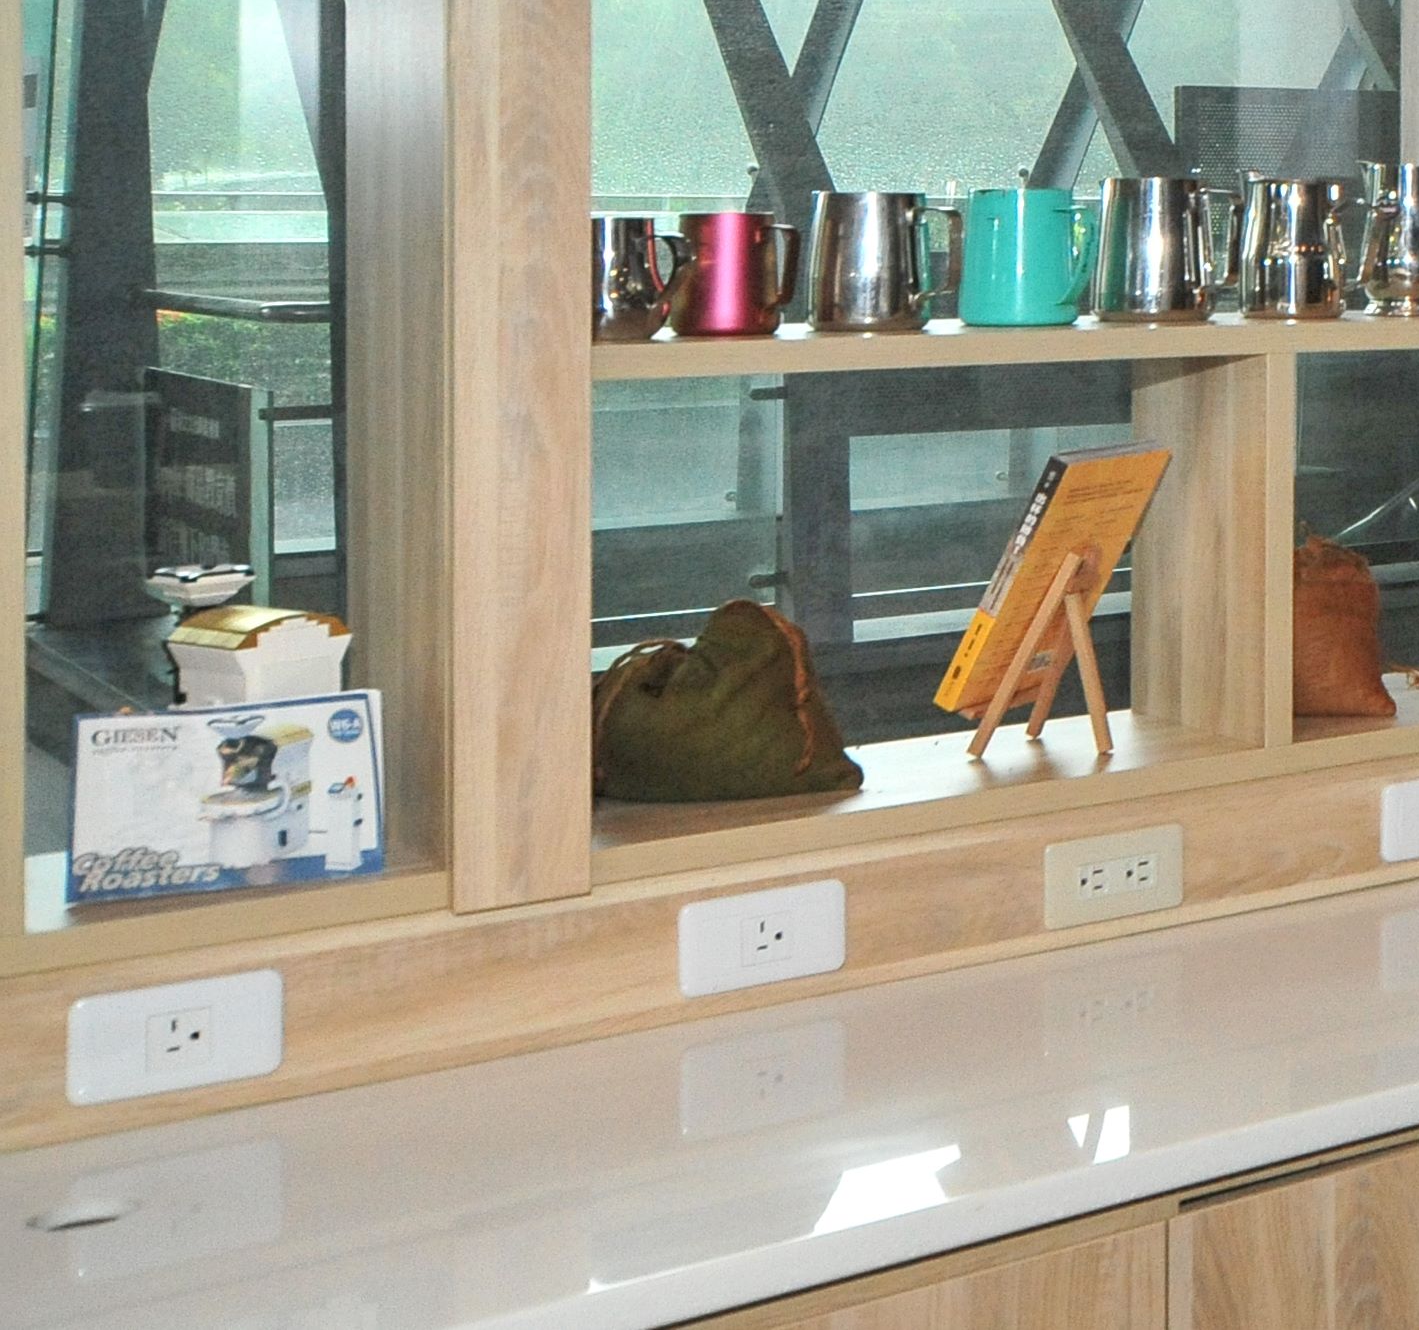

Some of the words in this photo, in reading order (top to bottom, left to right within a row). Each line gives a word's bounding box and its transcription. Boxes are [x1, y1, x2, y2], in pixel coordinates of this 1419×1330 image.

[91, 726, 181, 747] GIESEN
[73, 847, 179, 876] Coffee
[79, 863, 222, 893] Roasters
